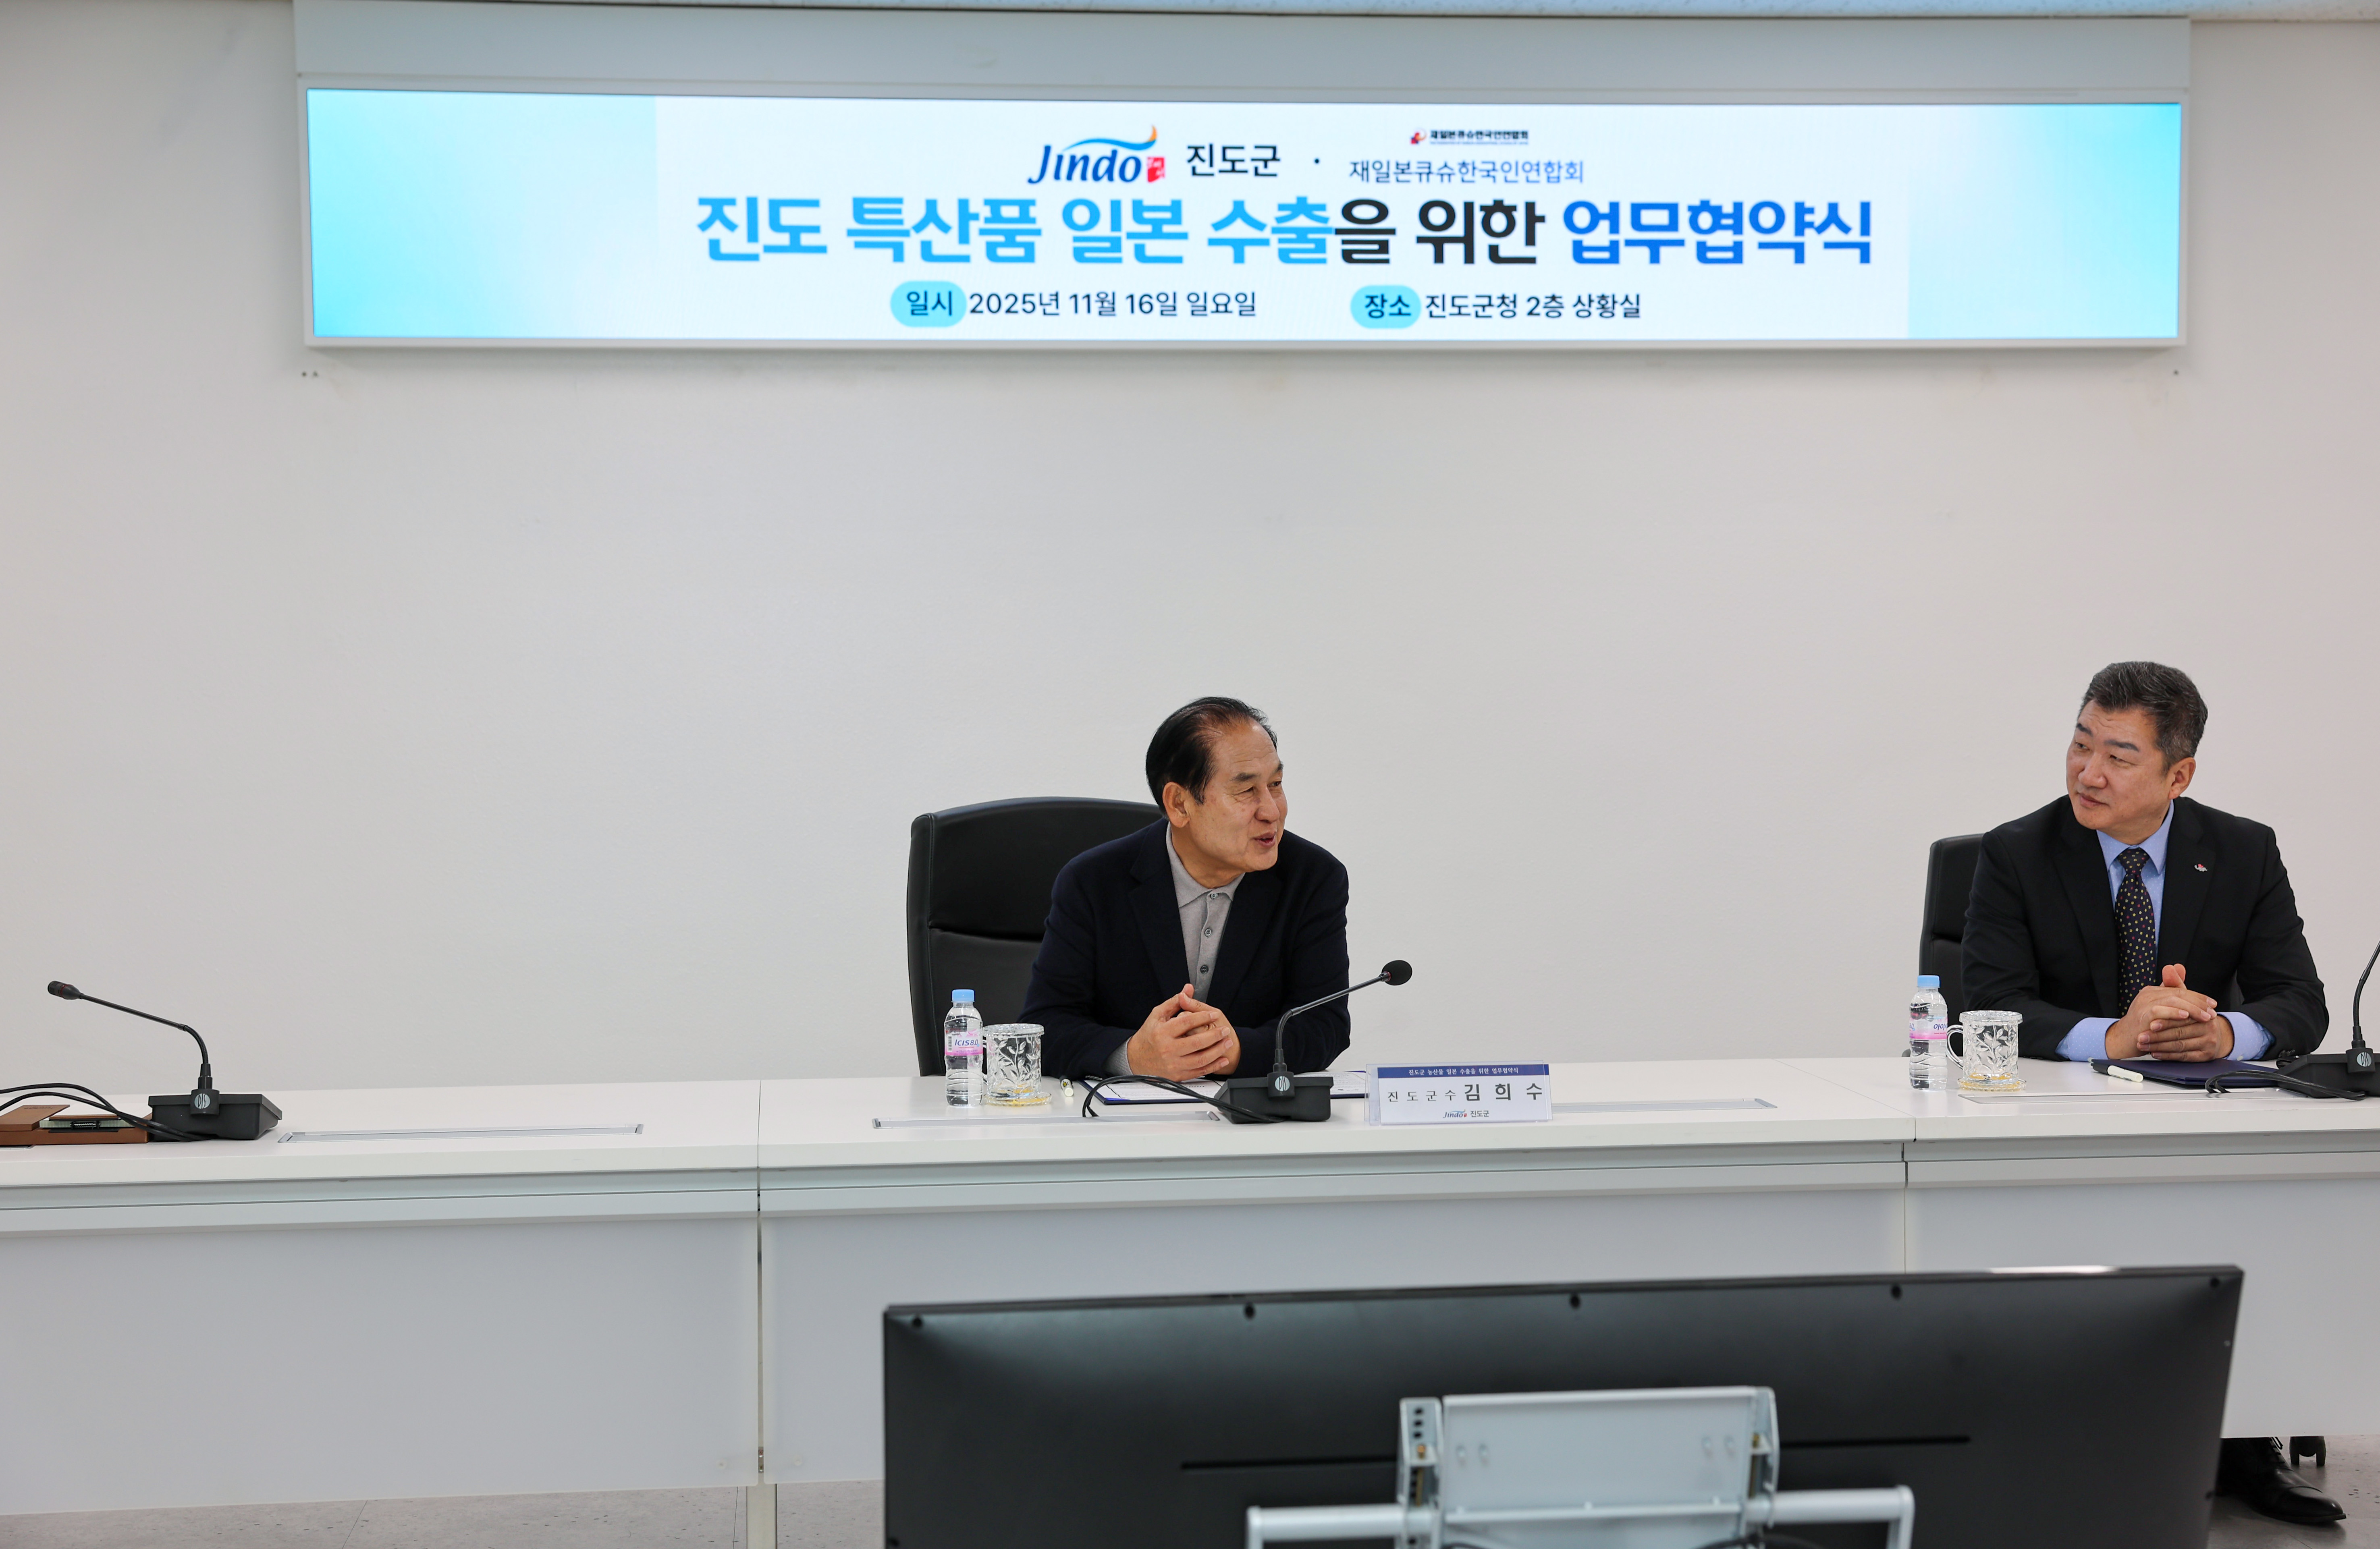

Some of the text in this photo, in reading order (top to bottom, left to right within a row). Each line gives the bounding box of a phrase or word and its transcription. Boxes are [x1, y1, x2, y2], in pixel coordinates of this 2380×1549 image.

[1027, 144, 1143, 185] Jindo
[1187, 143, 1281, 177] 진도군
[1349, 160, 1584, 184] 재일본큐슈한국인연합회
[697, 196, 1871, 265] 진도 특산품 일본 수출을 위한 업무협약식
[906, 290, 1256, 317] 일시 2025년 11월 16일 일요일
[1364, 293, 1641, 319] 장소 진도군청 2층 상황실
[1387, 1083, 1543, 1102] 진도군수 김희수
[1443, 1110, 1463, 1118] Jindo
